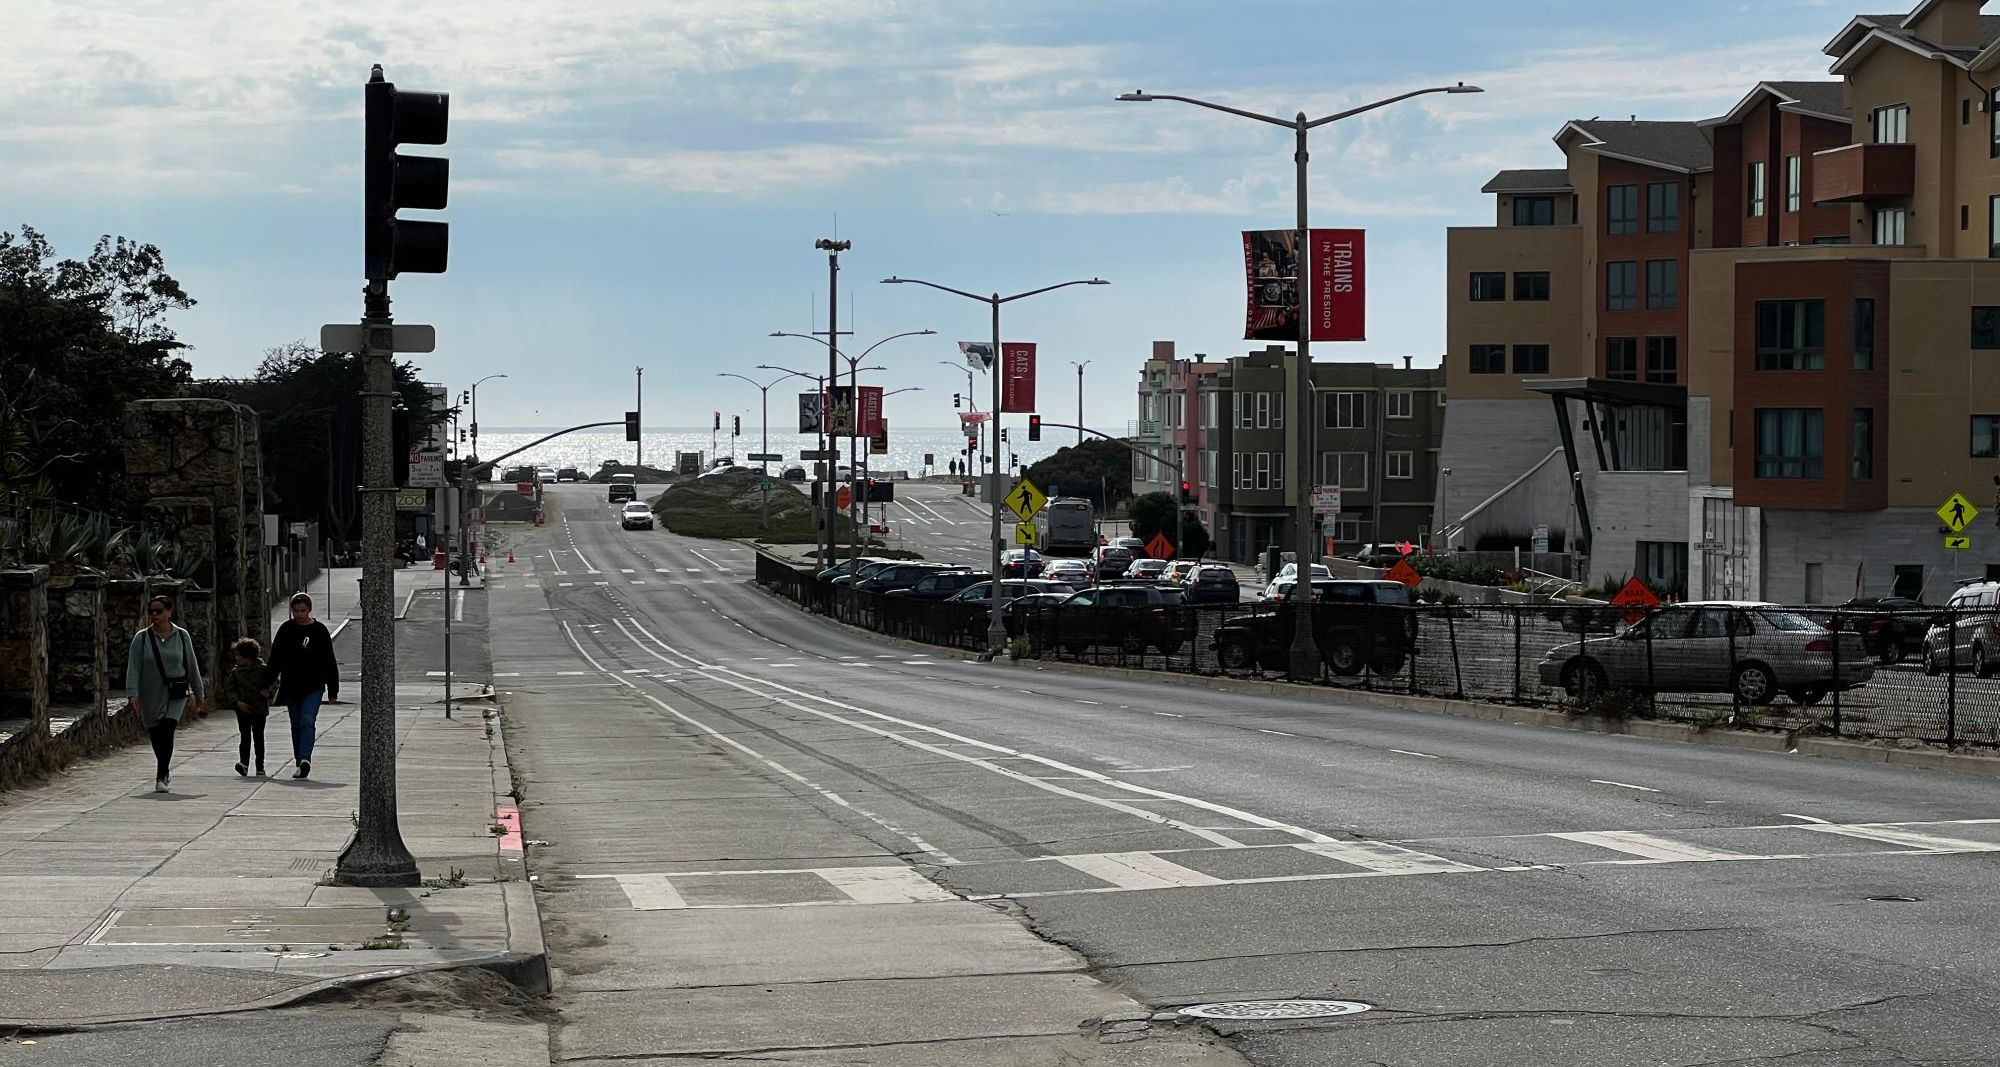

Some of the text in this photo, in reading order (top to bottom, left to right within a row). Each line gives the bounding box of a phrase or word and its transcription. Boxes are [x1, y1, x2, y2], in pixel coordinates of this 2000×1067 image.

[1334, 241, 1353, 293] TRAINS
[1323, 241, 1332, 329] IN THE PRESIDIO
[1016, 350, 1028, 373] CATS
[867, 391, 877, 421] CASTLES
[410, 453, 419, 463] NO
[1313, 486, 1321, 494] NO
[1624, 589, 1646, 597] ROAD
